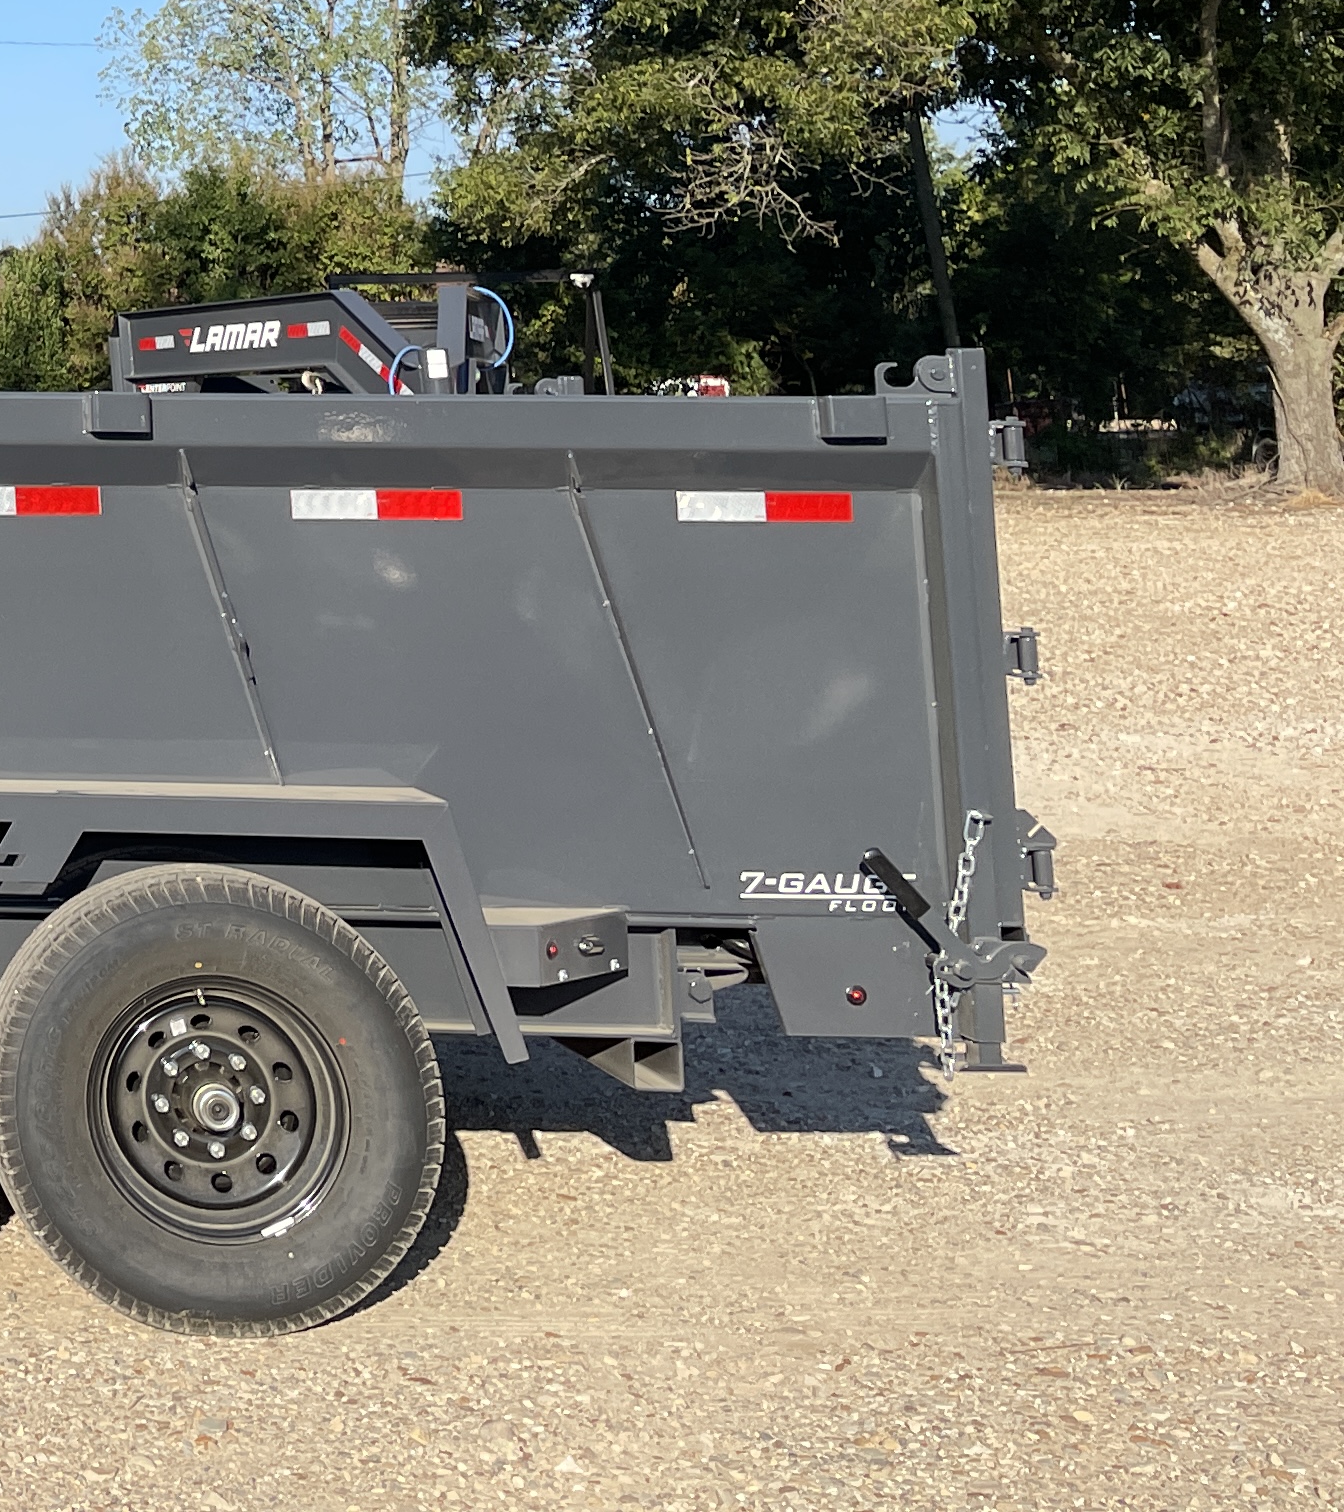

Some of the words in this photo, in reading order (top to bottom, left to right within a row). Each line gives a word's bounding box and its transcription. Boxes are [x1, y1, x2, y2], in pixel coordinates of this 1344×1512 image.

[189, 319, 281, 353] LAMAR
[739, 871, 917, 894] 7-GAUG
[828, 900, 909, 912] FLOO
[270, 1180, 404, 1306] PROVIDER
